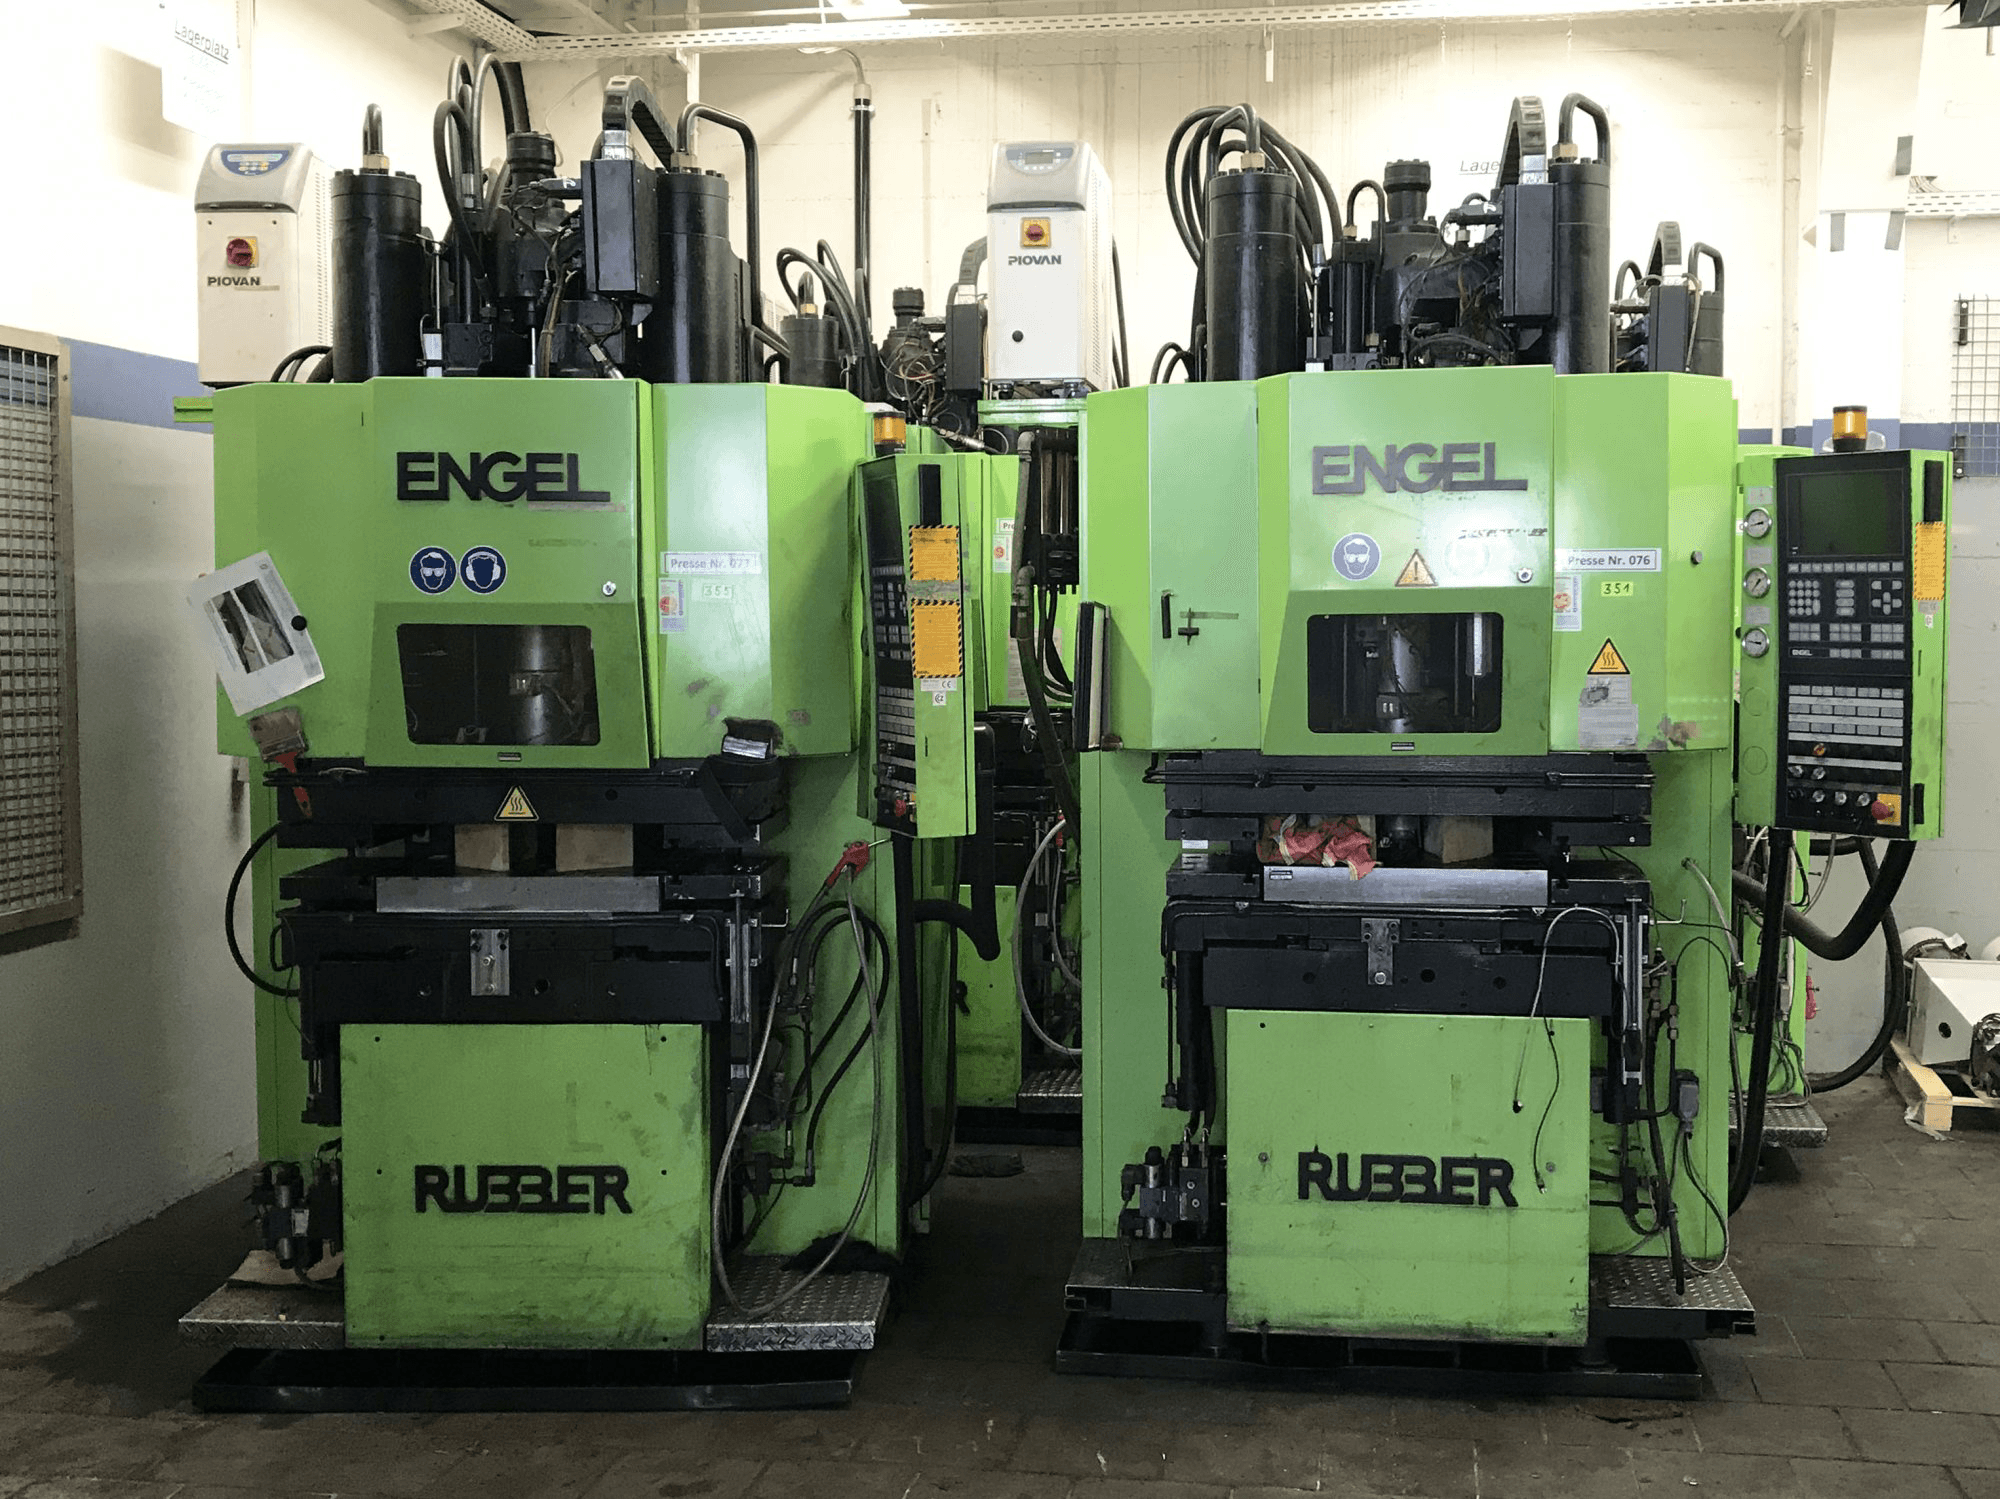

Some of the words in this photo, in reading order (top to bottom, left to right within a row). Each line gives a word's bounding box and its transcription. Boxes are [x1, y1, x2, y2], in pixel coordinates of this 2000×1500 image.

[174, 17, 230, 62] Lagerplatz
[1460, 160, 1501, 174] Lage
[1008, 255, 1062, 266] PIOVAN
[206, 276, 261, 287] PIOVAN
[396, 451, 611, 502] ENGEL
[1312, 441, 1528, 494] ENGEL
[670, 558, 707, 569] Presse
[1568, 555, 1605, 566] Presse
[1608, 555, 1626, 566] Nr.
[1628, 555, 1651, 566] 076
[414, 1164, 633, 1214] RUBBER
[1299, 1152, 1518, 1207] RUBBER
